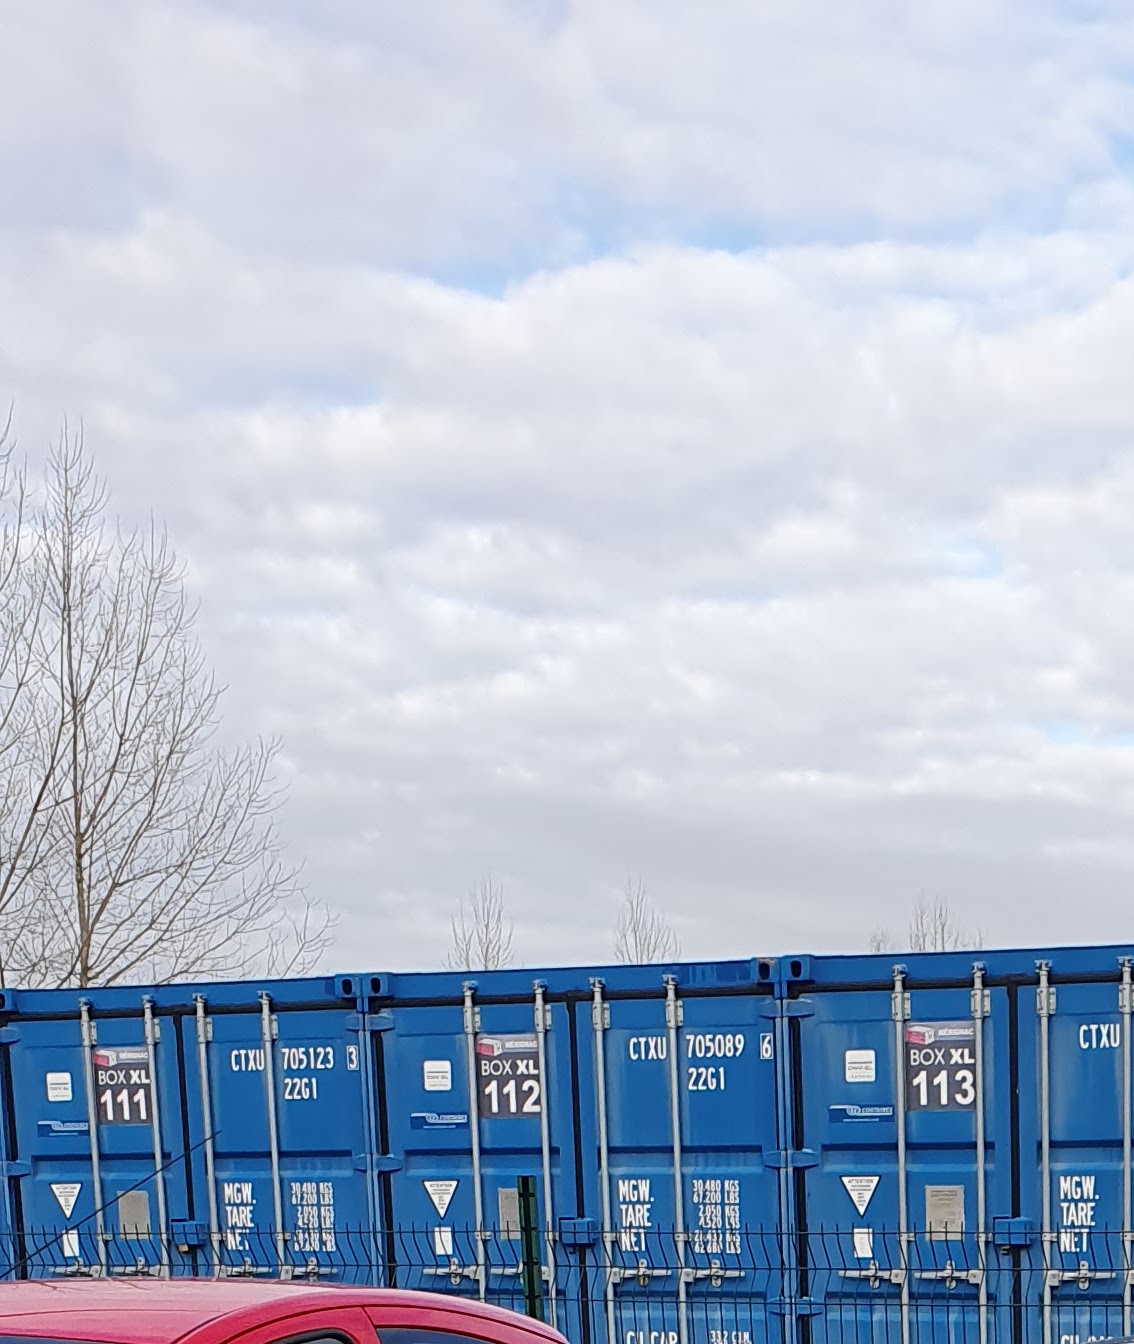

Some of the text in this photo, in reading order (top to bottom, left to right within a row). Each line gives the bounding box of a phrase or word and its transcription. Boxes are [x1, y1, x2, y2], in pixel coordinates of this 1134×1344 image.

[629, 1034, 772, 1060] CTXU 705089 6
[1080, 1024, 1120, 1049] CTXU
[231, 1046, 358, 1072] CTXU 705123 3
[482, 1059, 538, 1076] BOX XL
[910, 1048, 975, 1066] BOX XL
[98, 1070, 150, 1085] BOX XL
[284, 1077, 318, 1100] 22G1
[688, 1067, 725, 1090] 22G1
[913, 1070, 975, 1106] 113
[100, 1088, 147, 1121] 111
[484, 1080, 540, 1113] 112
[224, 1183, 256, 1205] MGW.
[618, 1180, 654, 1202] MGW.
[692, 1180, 739, 1191] 30.480 KGS
[1060, 1176, 1100, 1200] MGW.
[693, 1192, 739, 1203] 67.200 LBS
[226, 1206, 254, 1228] TARE
[620, 1205, 652, 1227] TARE
[725, 1205, 739, 1216] KGS
[1060, 1202, 1095, 1226] TARE
[621, 1230, 646, 1252] NET
[1060, 1229, 1088, 1252] NET
